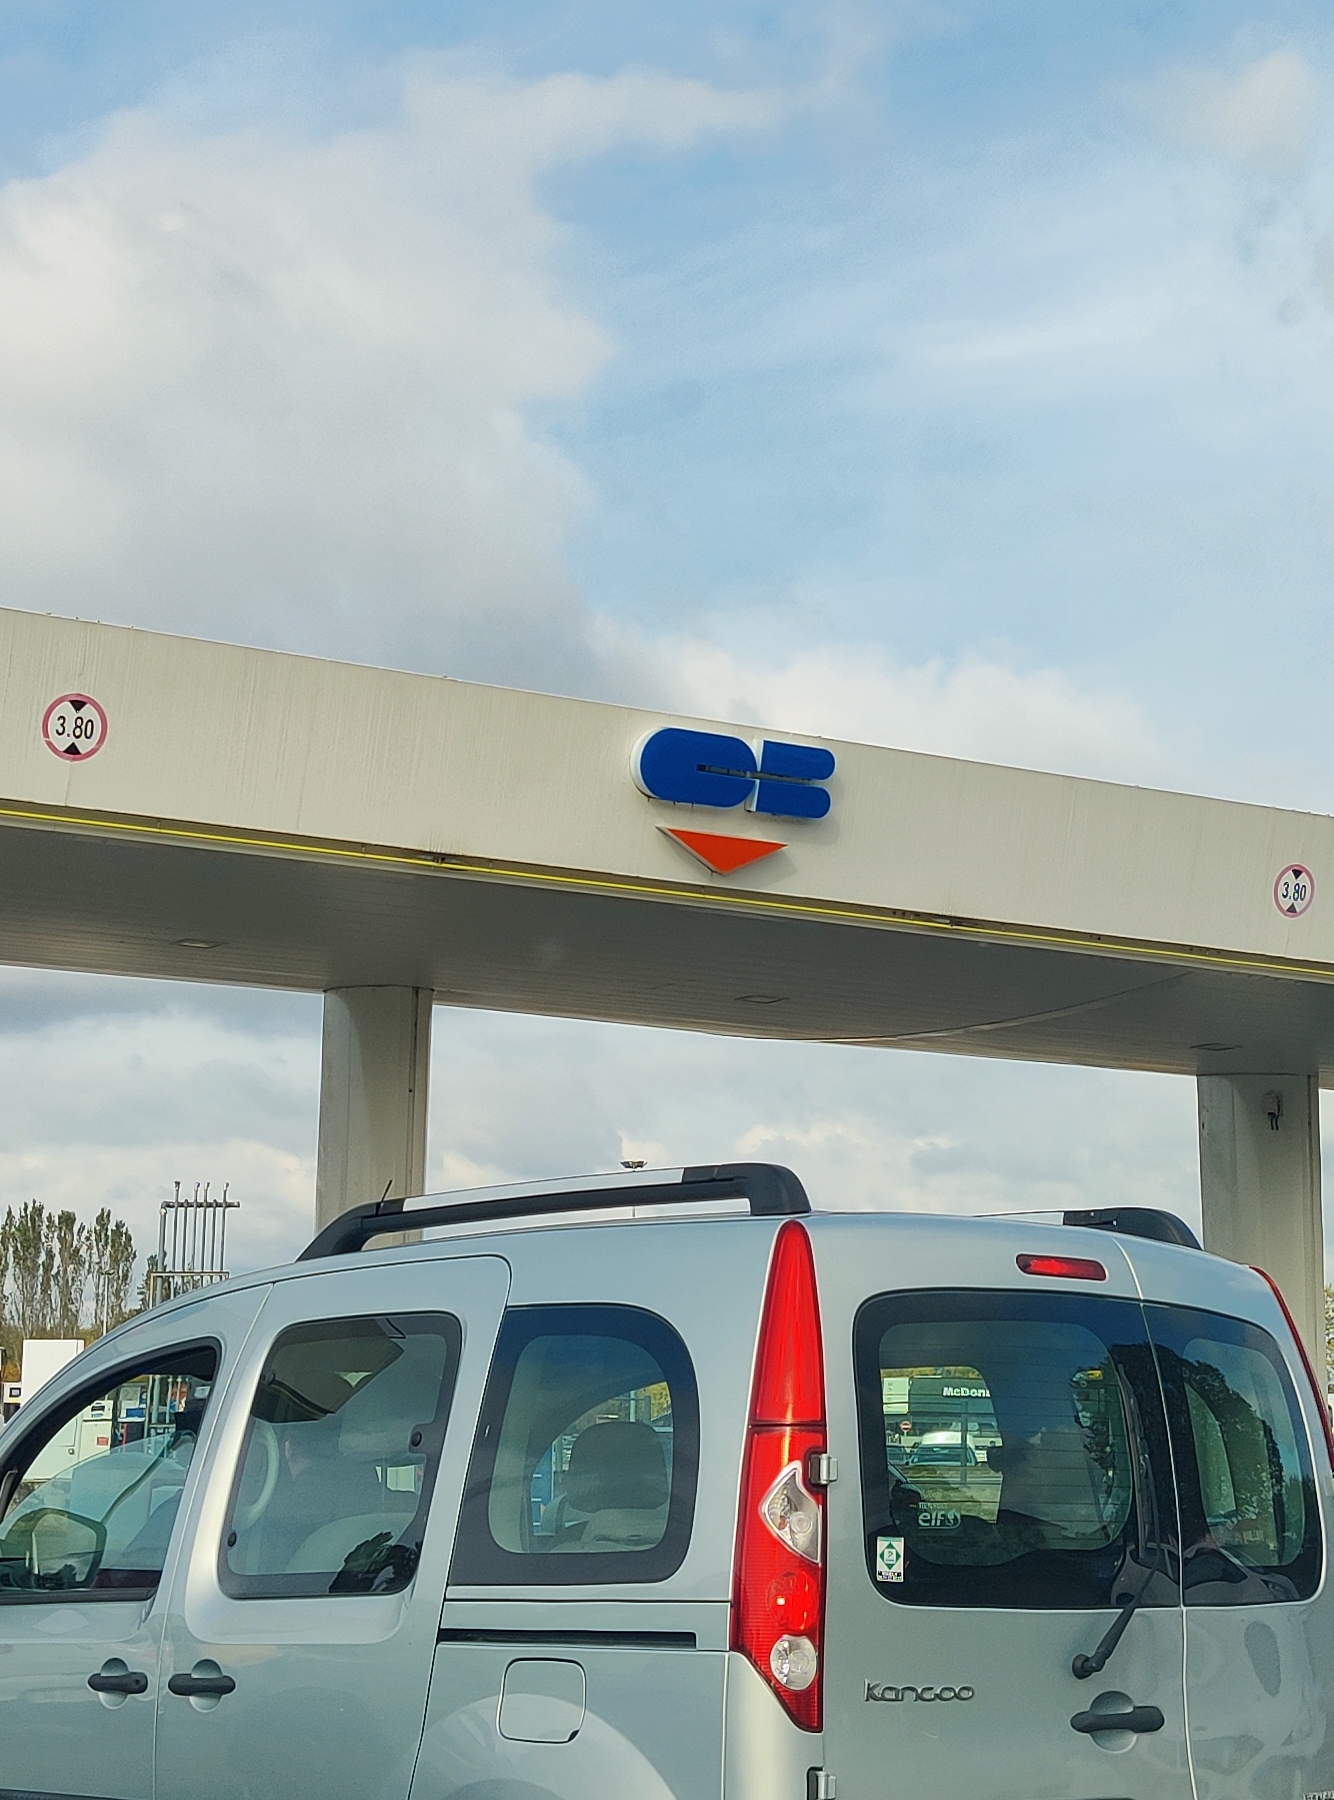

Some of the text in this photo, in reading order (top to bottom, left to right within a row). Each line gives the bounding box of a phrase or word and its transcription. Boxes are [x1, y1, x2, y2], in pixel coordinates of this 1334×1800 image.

[55, 715, 95, 740] 3.80
[1281, 881, 1307, 902] 3.80
[918, 1511, 945, 1527] elf
[864, 1679, 975, 1702] Kangoo
